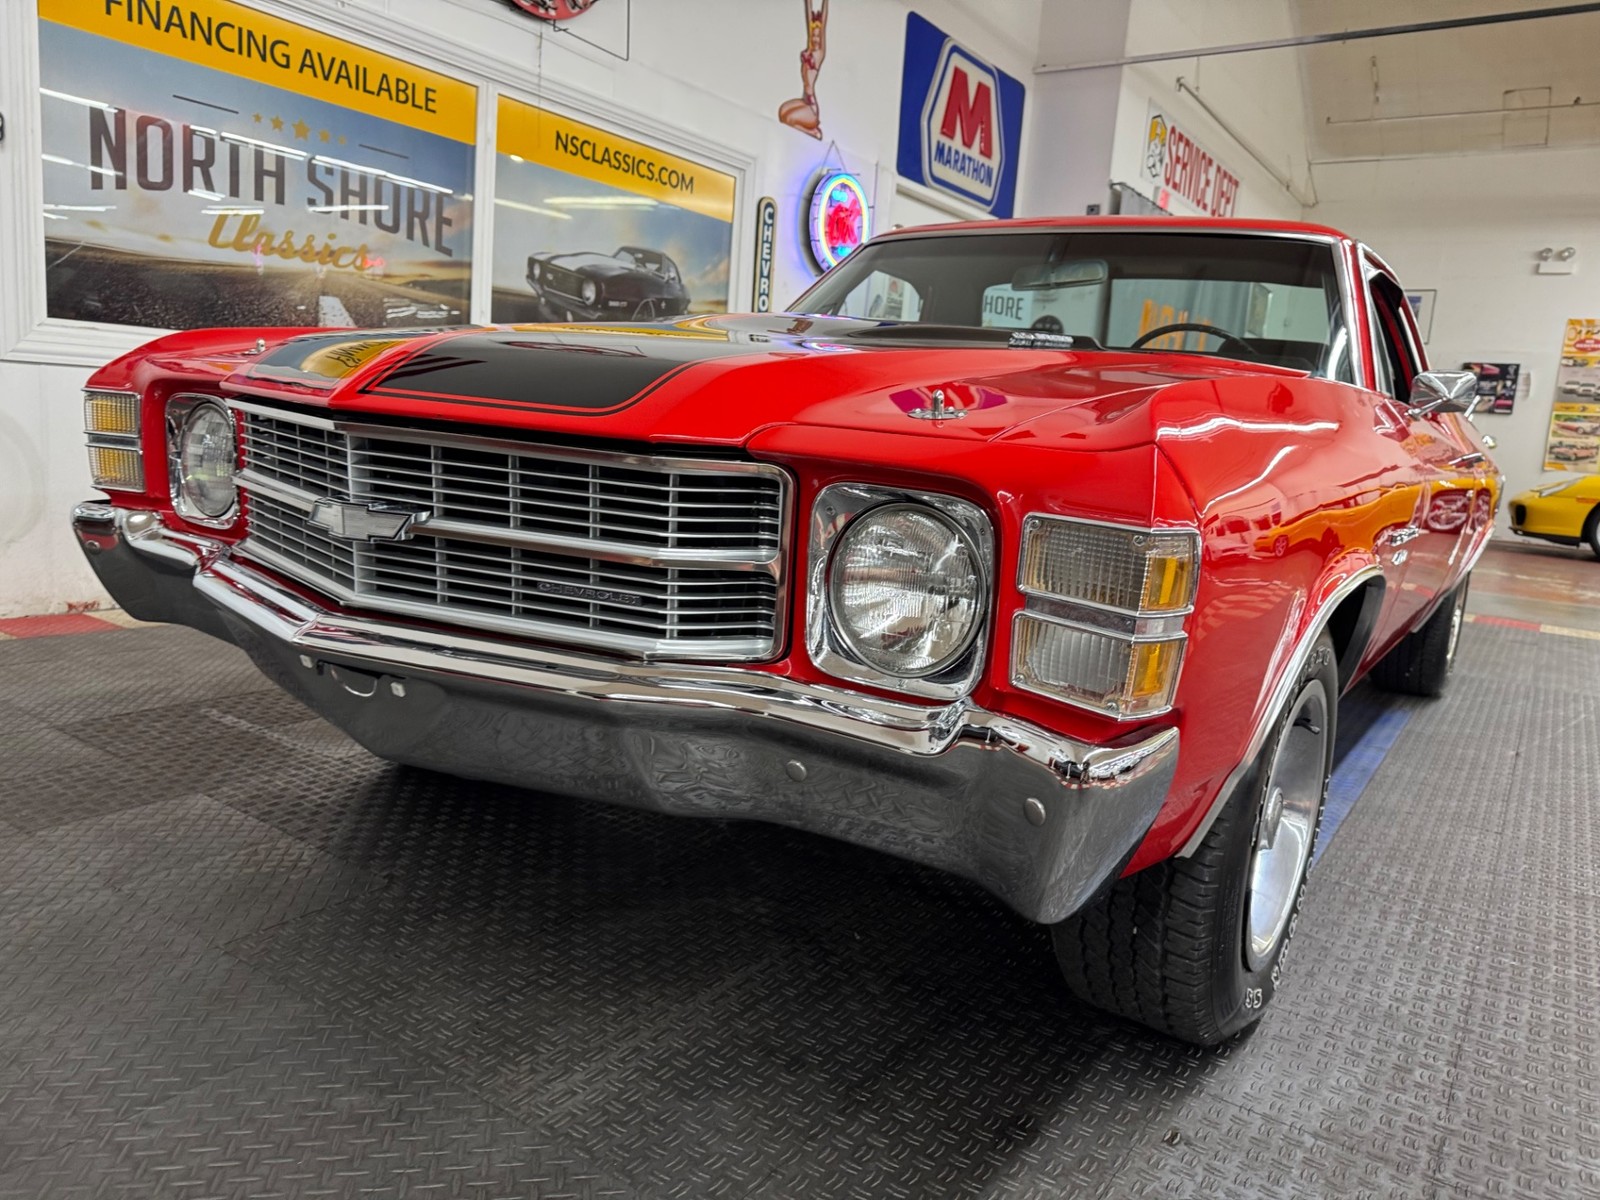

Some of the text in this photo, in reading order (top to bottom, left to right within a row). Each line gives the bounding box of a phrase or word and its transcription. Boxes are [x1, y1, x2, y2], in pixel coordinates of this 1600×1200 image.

[298, 48, 437, 114] AVAILABLE
[940, 65, 993, 160] M
[89, 105, 454, 258] NORTH SHORE
[554, 130, 695, 194] NSCLASSICS.COM
[934, 140, 994, 188] MARATHON
[1164, 125, 1239, 217] SERVICE DEPT
[207, 206, 375, 272] Classics
[538, 582, 640, 605] CHEVROLET
